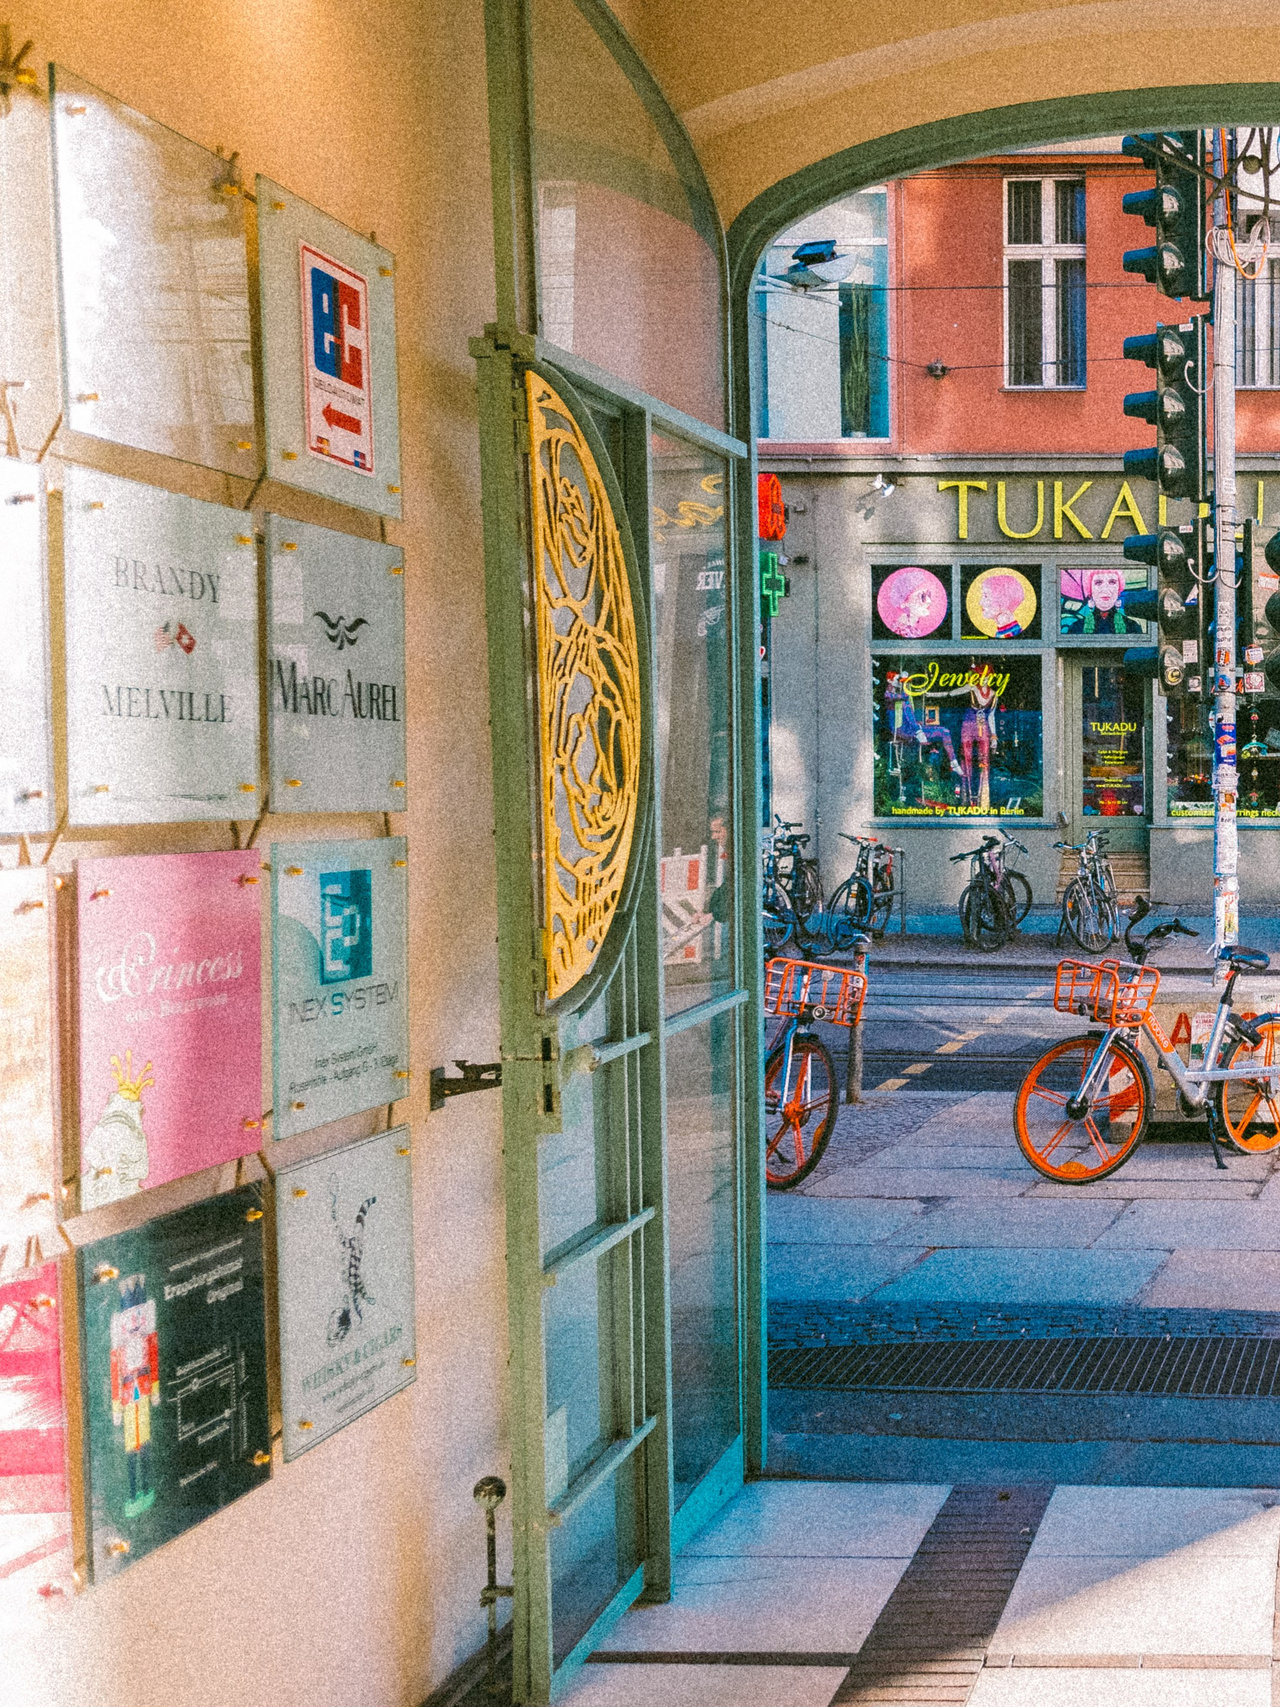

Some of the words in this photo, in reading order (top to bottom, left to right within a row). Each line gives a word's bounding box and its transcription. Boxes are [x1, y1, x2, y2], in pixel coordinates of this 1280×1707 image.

[113, 556, 221, 604] BRANDY
[276, 659, 338, 717] MARC
[340, 668, 400, 722] AUREL
[903, 662, 1011, 696] Jewelry
[100, 685, 233, 724] MELVILLE
[1090, 722, 1137, 732] TUKADU
[892, 806, 933, 815] handmade
[935, 806, 945, 818] by
[947, 806, 988, 815] TUKADU
[990, 806, 998, 815] in
[1000, 806, 1025, 815] Berlin
[97, 932, 243, 1003] Princess
[331, 980, 399, 1016] SYSTEM
[1147, 1014, 1170, 1049] mobike
